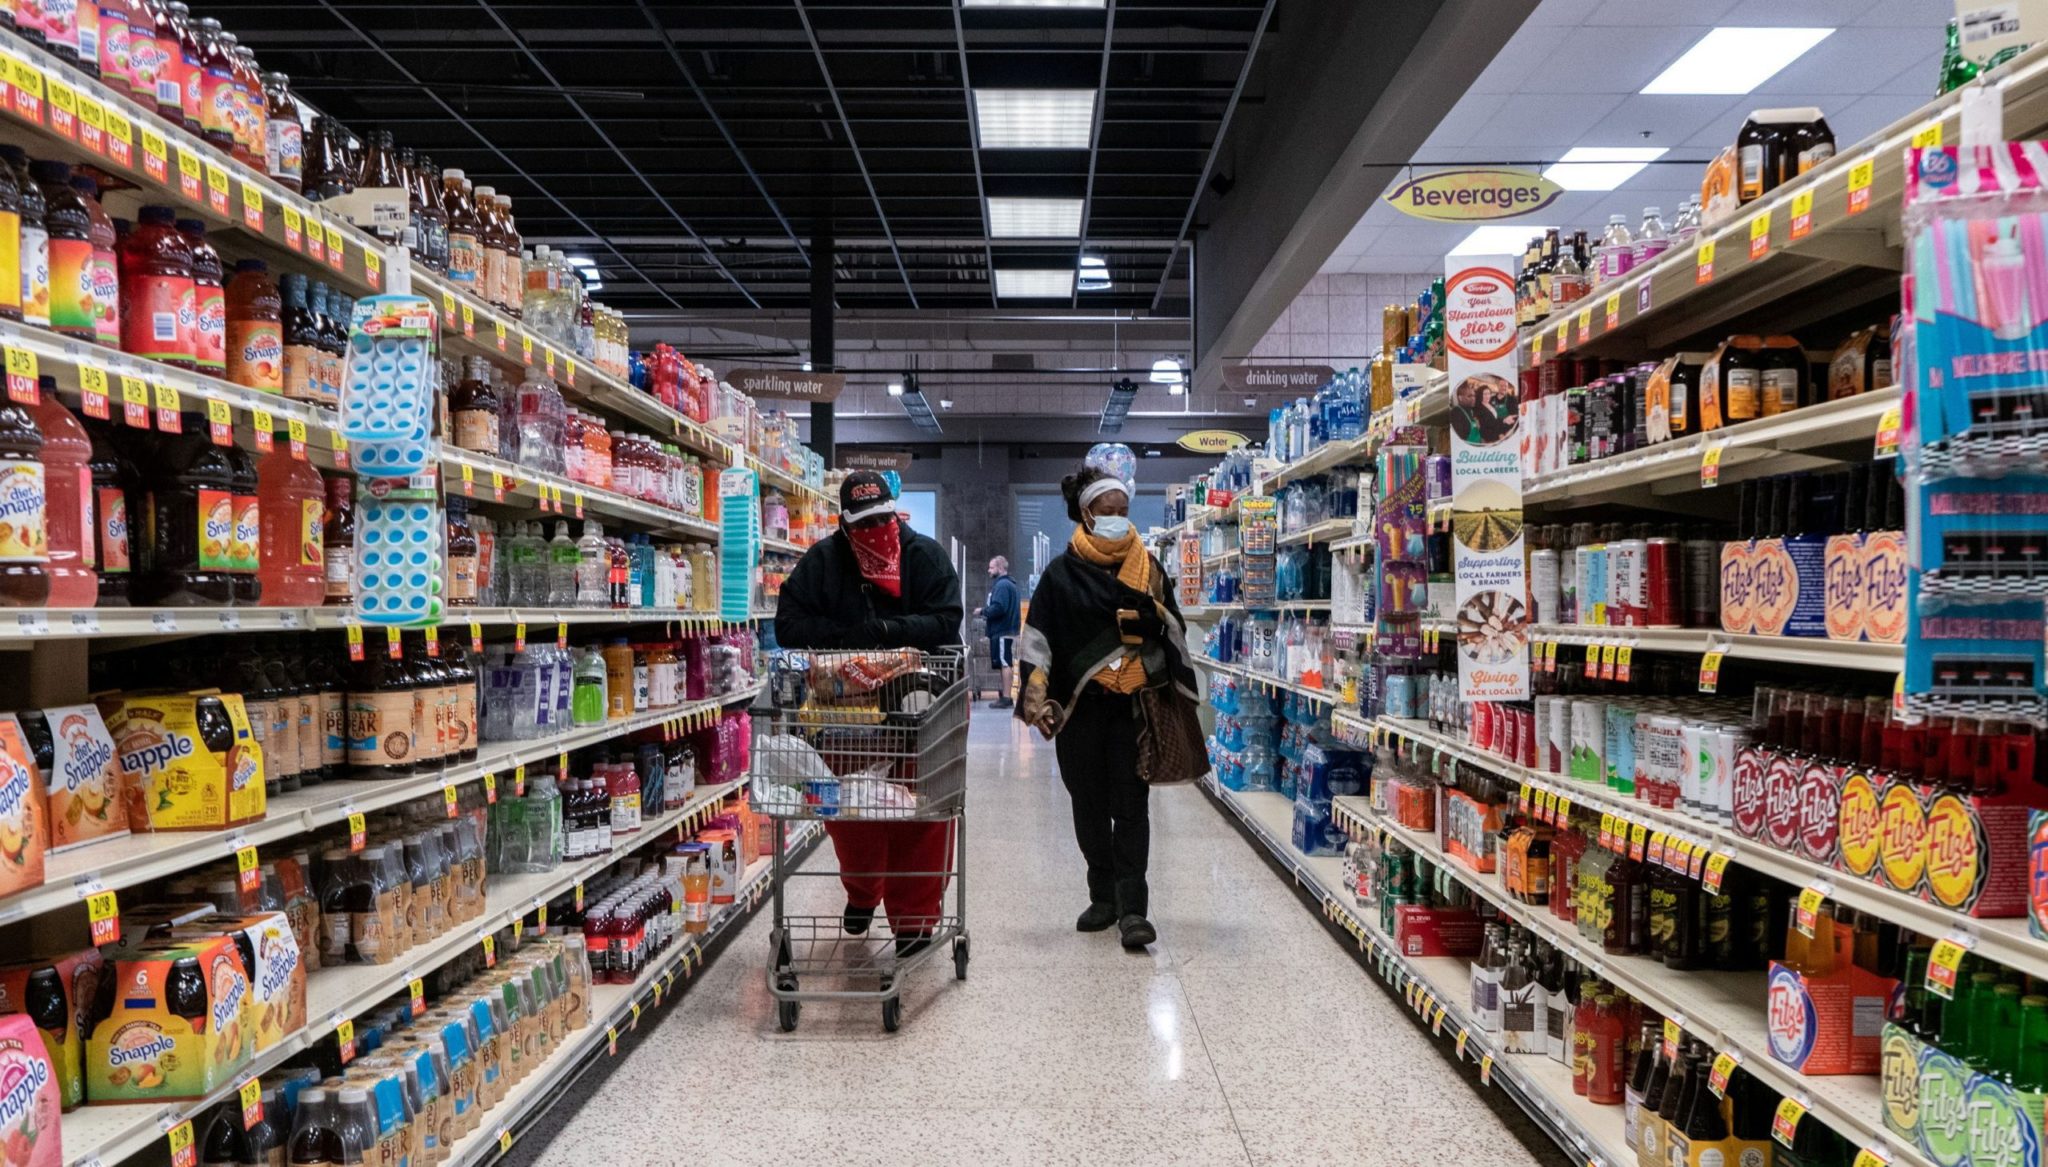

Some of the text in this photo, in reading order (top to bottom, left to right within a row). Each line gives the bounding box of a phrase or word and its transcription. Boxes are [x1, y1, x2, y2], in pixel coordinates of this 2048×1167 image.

[1412, 186, 1541, 209] Beverages
[1467, 298, 1492, 308] Your
[1448, 306, 1513, 322] Hometown
[1460, 321, 1505, 339] Store
[743, 375, 823, 395] sparkling water
[1246, 370, 1318, 388] drinking water
[1199, 436, 1228, 447] Water
[846, 455, 897, 468] sparkling water
[1455, 450, 1518, 469] Building
[1456, 466, 1519, 476] LOCAL CAREERS
[10, 487, 34, 501] diet
[1458, 556, 1522, 574] Supporting
[1482, 571, 1522, 579] FARMERS
[1478, 578, 1510, 586] BRANDS
[1723, 558, 1753, 607] Fitz's
[1753, 557, 1784, 607] Fitz's
[1828, 554, 1862, 612] Fitz's
[1866, 553, 1907, 612] Fitz's
[1263, 628, 1273, 657] core
[1470, 670, 1519, 688] Giving
[1466, 688, 1523, 697] BACK LOCALLY
[75, 741, 92, 762] diet
[65, 741, 111, 791] Snapple
[233, 761, 257, 791] Snapple
[1734, 763, 1765, 812] Fitz's
[1766, 773, 1799, 823] Fitz's
[1801, 782, 1837, 836] Fitz's
[1882, 803, 1929, 862] Fitz's
[1928, 813, 1978, 877] Fitz's
[241, 870, 257, 885] LOW
[93, 919, 114, 937] LOW
[136, 969, 147, 985] 6
[262, 948, 297, 1002] Snapple
[214, 974, 245, 1032] Snapple
[1769, 987, 1805, 1039] Fitz's
[110, 1037, 174, 1066] Snapple
[244, 1103, 258, 1120] LOW
[1919, 1073, 1969, 1139] Fitz's
[174, 1147, 191, 1166] LOW
